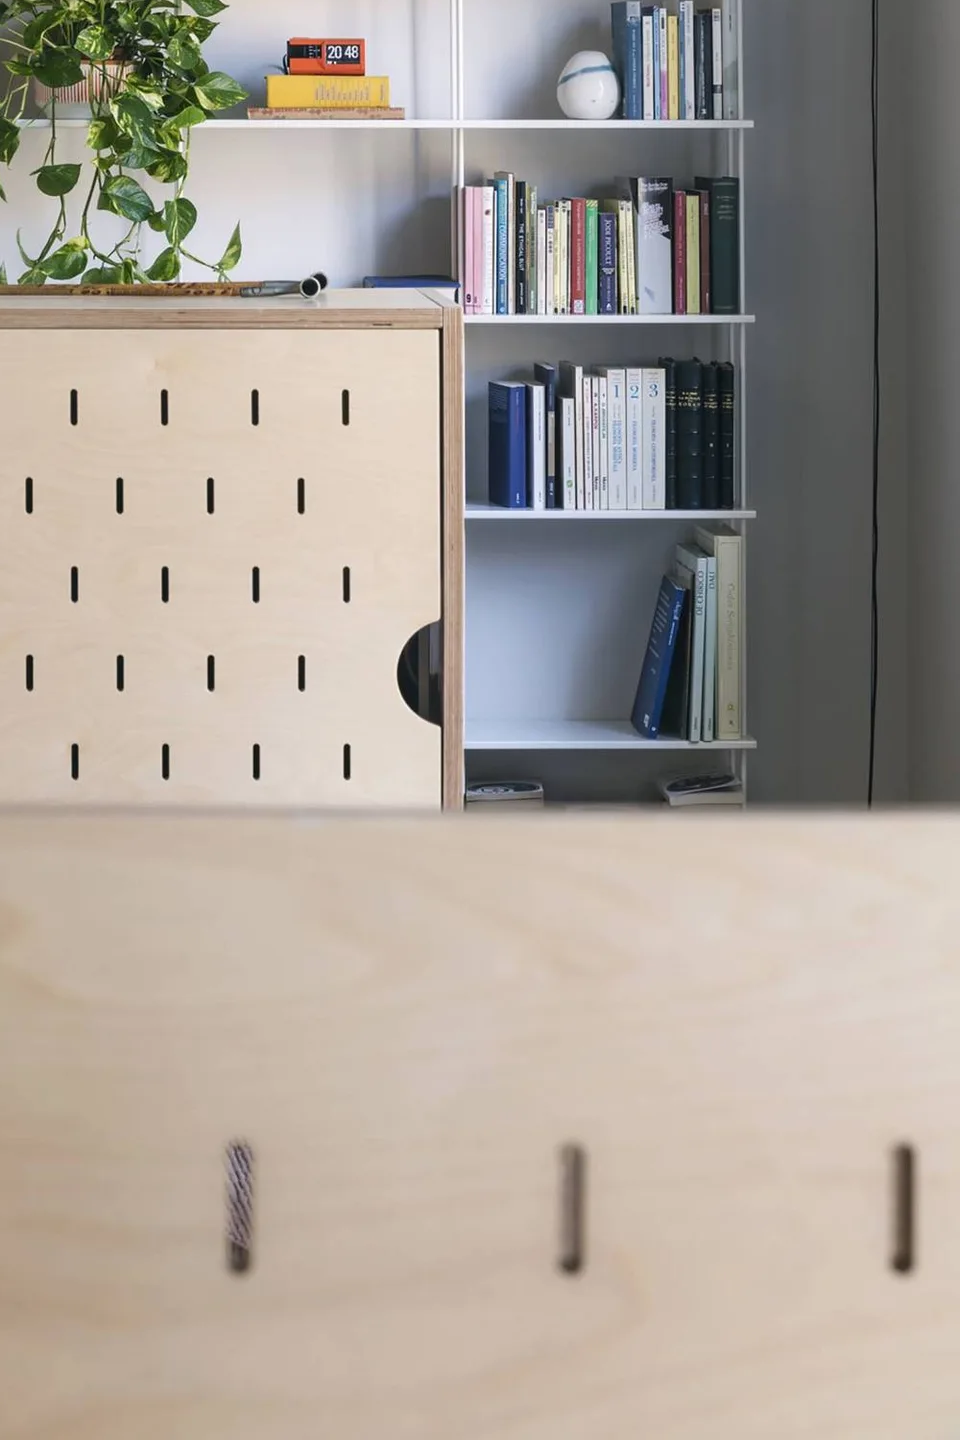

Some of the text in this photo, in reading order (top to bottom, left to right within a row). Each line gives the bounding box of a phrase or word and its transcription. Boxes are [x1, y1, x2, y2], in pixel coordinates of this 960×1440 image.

[327, 45, 359, 59] 20 48
[499, 225, 507, 281] COMMUNICATION
[614, 385, 619, 398] 1
[630, 385, 640, 399] 2
[648, 384, 659, 398] 3
[696, 604, 704, 616] DE
